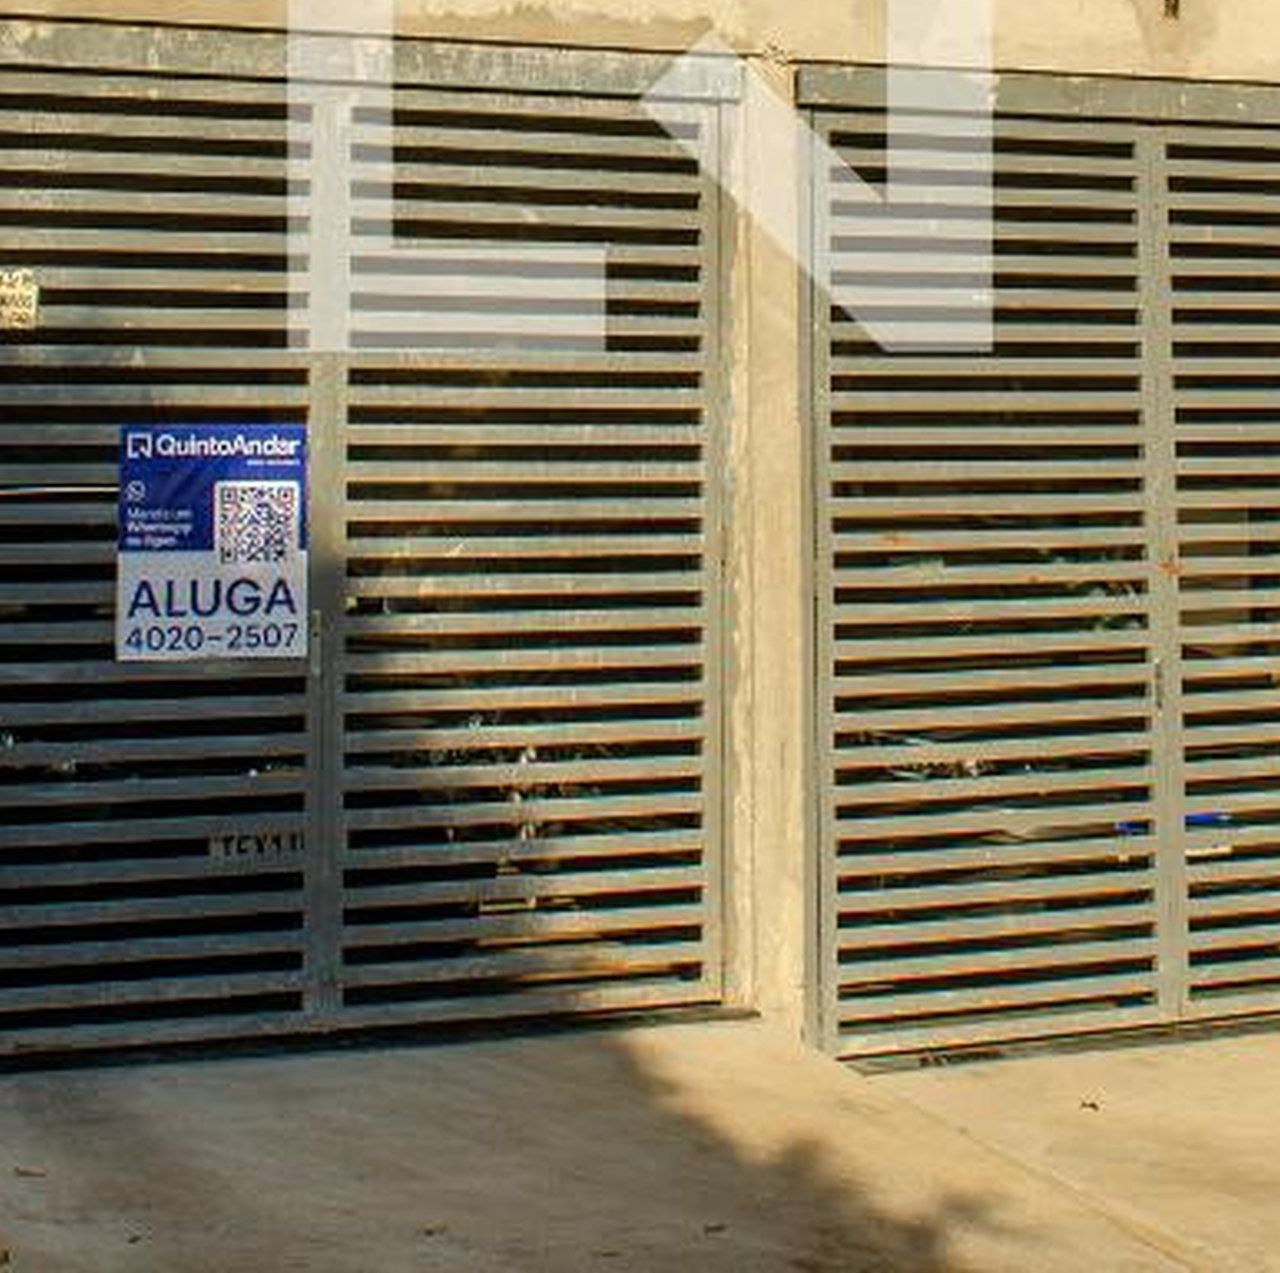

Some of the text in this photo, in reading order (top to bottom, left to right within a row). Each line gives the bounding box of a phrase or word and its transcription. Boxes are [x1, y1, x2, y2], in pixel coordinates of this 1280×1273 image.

[156, 434, 301, 457] QuintoAndar
[127, 579, 297, 618] ALUGA
[126, 624, 298, 652] 4020-2507
